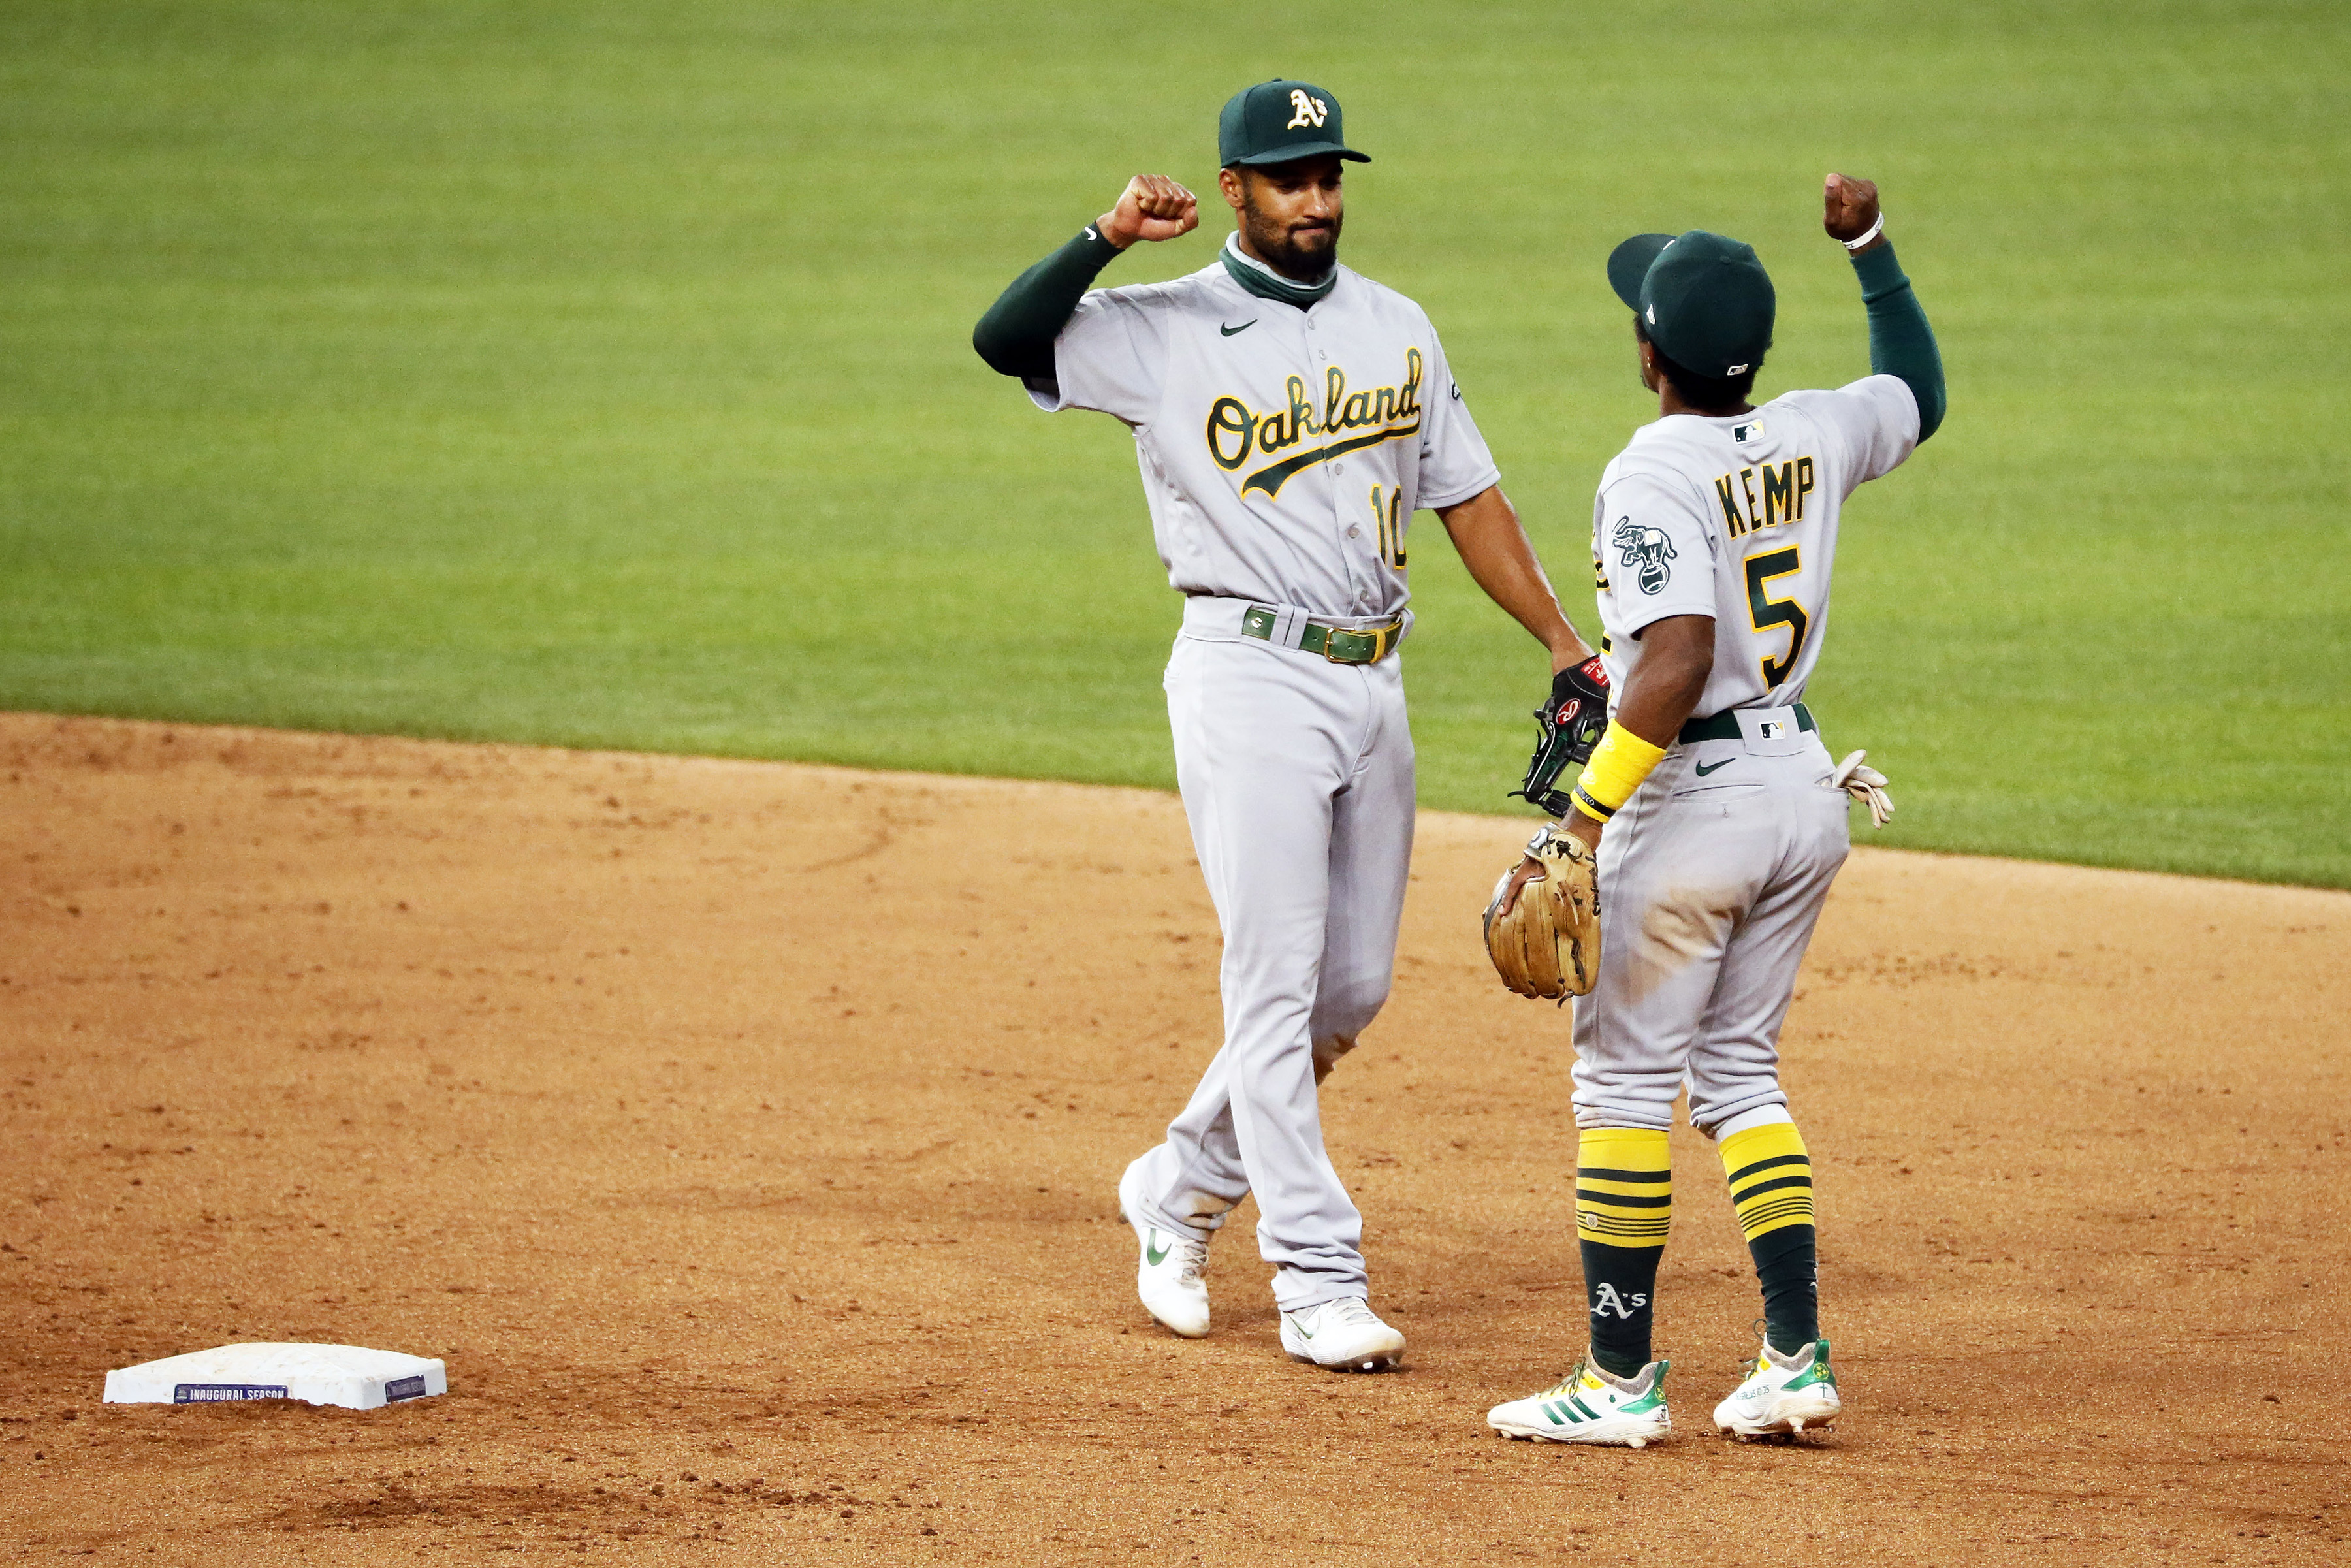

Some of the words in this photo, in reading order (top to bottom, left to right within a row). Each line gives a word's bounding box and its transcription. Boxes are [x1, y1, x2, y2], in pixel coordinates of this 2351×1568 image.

[1288, 90, 1328, 129] A's
[1207, 347, 1424, 471] Oakland
[1370, 483, 1407, 569] 10
[1716, 456, 1814, 540] KEMP
[1744, 544, 1809, 694] 5
[1590, 1282, 1646, 1319] A's
[190, 1390, 244, 1400] INAUGURAL
[248, 1390, 284, 1400] SEASON
